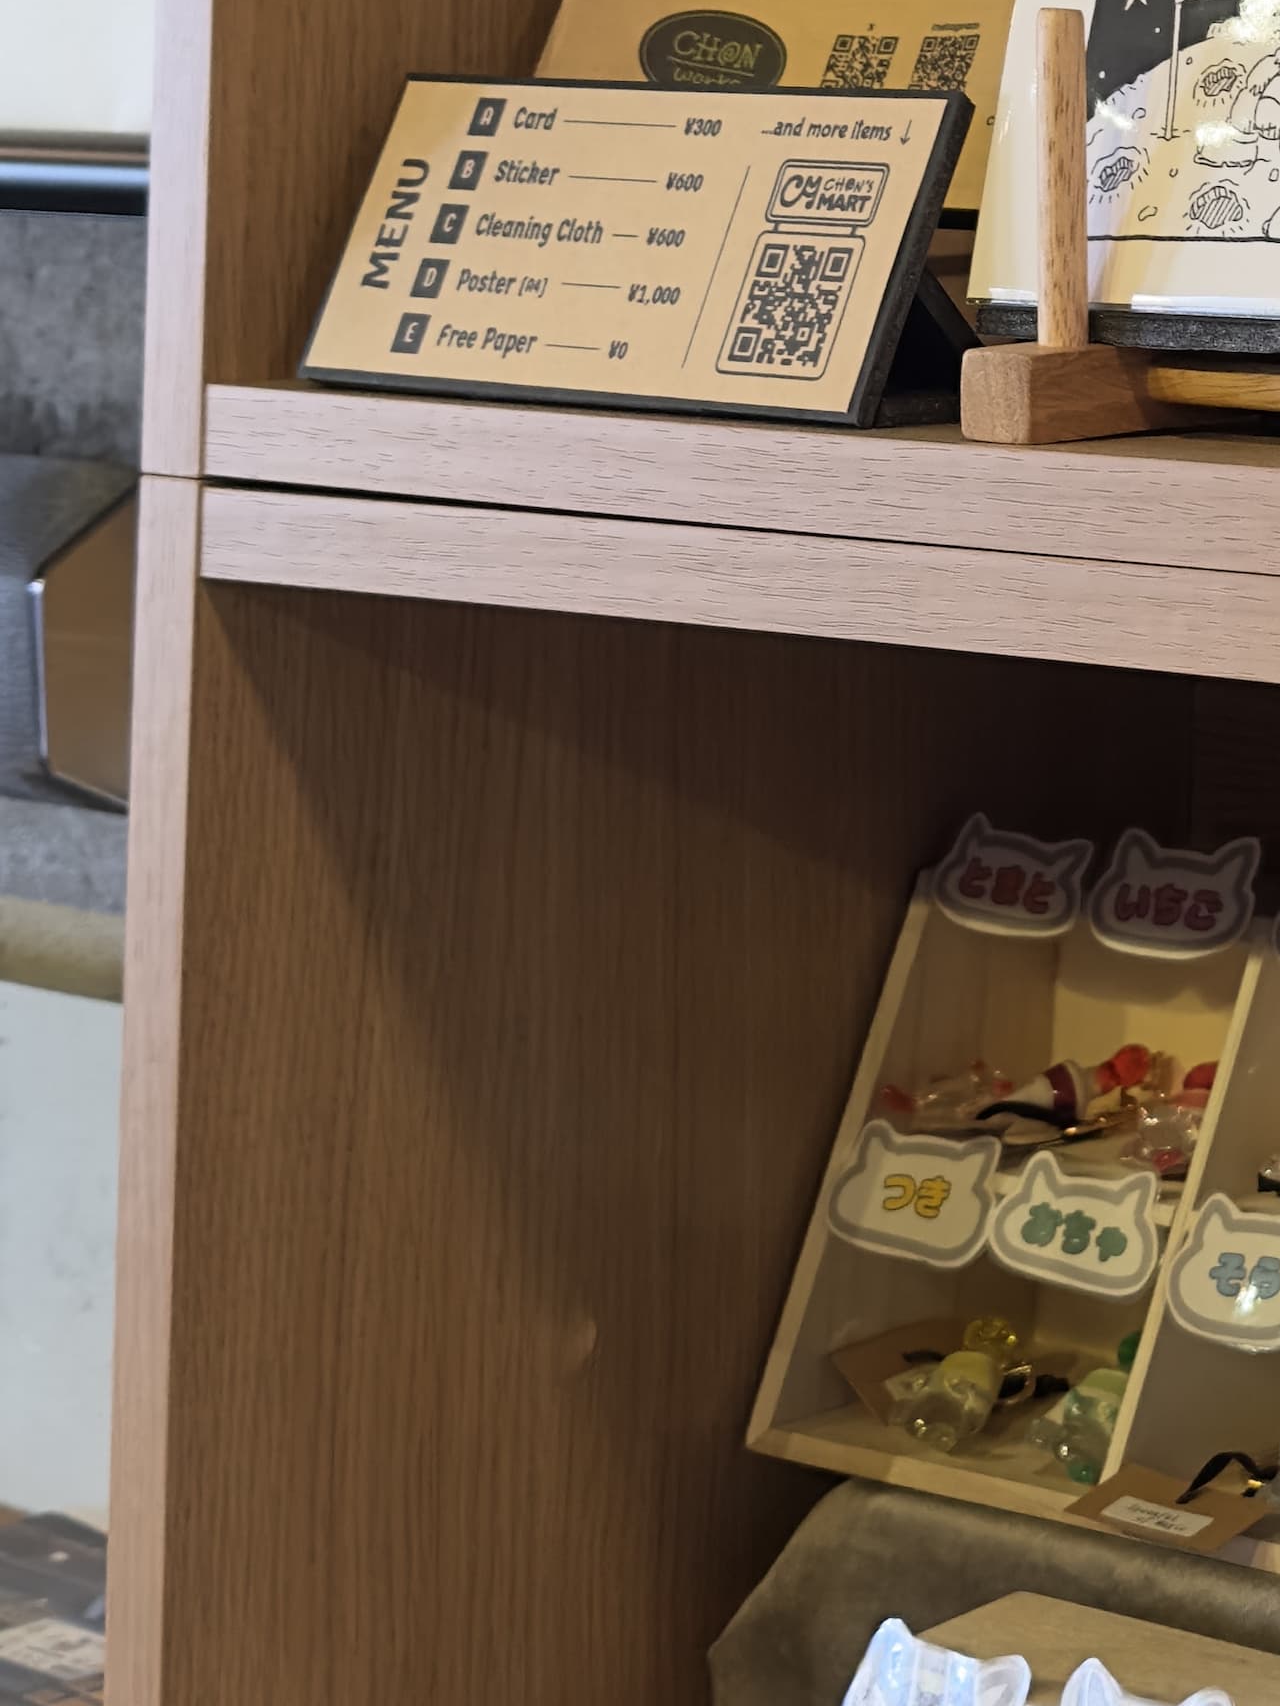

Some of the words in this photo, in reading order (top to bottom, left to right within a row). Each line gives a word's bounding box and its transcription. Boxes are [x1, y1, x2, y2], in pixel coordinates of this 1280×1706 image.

[513, 107, 558, 131] Card
[683, 117, 722, 138] ¥300
[807, 122, 848, 140] more
[850, 120, 892, 142] items
[493, 159, 561, 186] Sticker
[665, 172, 704, 193] ¥600
[816, 193, 872, 214] MART
[361, 158, 431, 290] MENU
[475, 212, 553, 247] Cleaning
[556, 218, 604, 245] Cloth
[646, 226, 686, 248] ¥600
[456, 268, 517, 296] Poster
[626, 283, 682, 307] ¥1,000
[436, 324, 479, 349] Free
[481, 326, 538, 359] Paper
[607, 339, 629, 360] ¥0
[1113, 881, 1225, 932] いちご
[881, 1172, 953, 1221] つき
[1021, 1201, 1129, 1264] おちゃ
